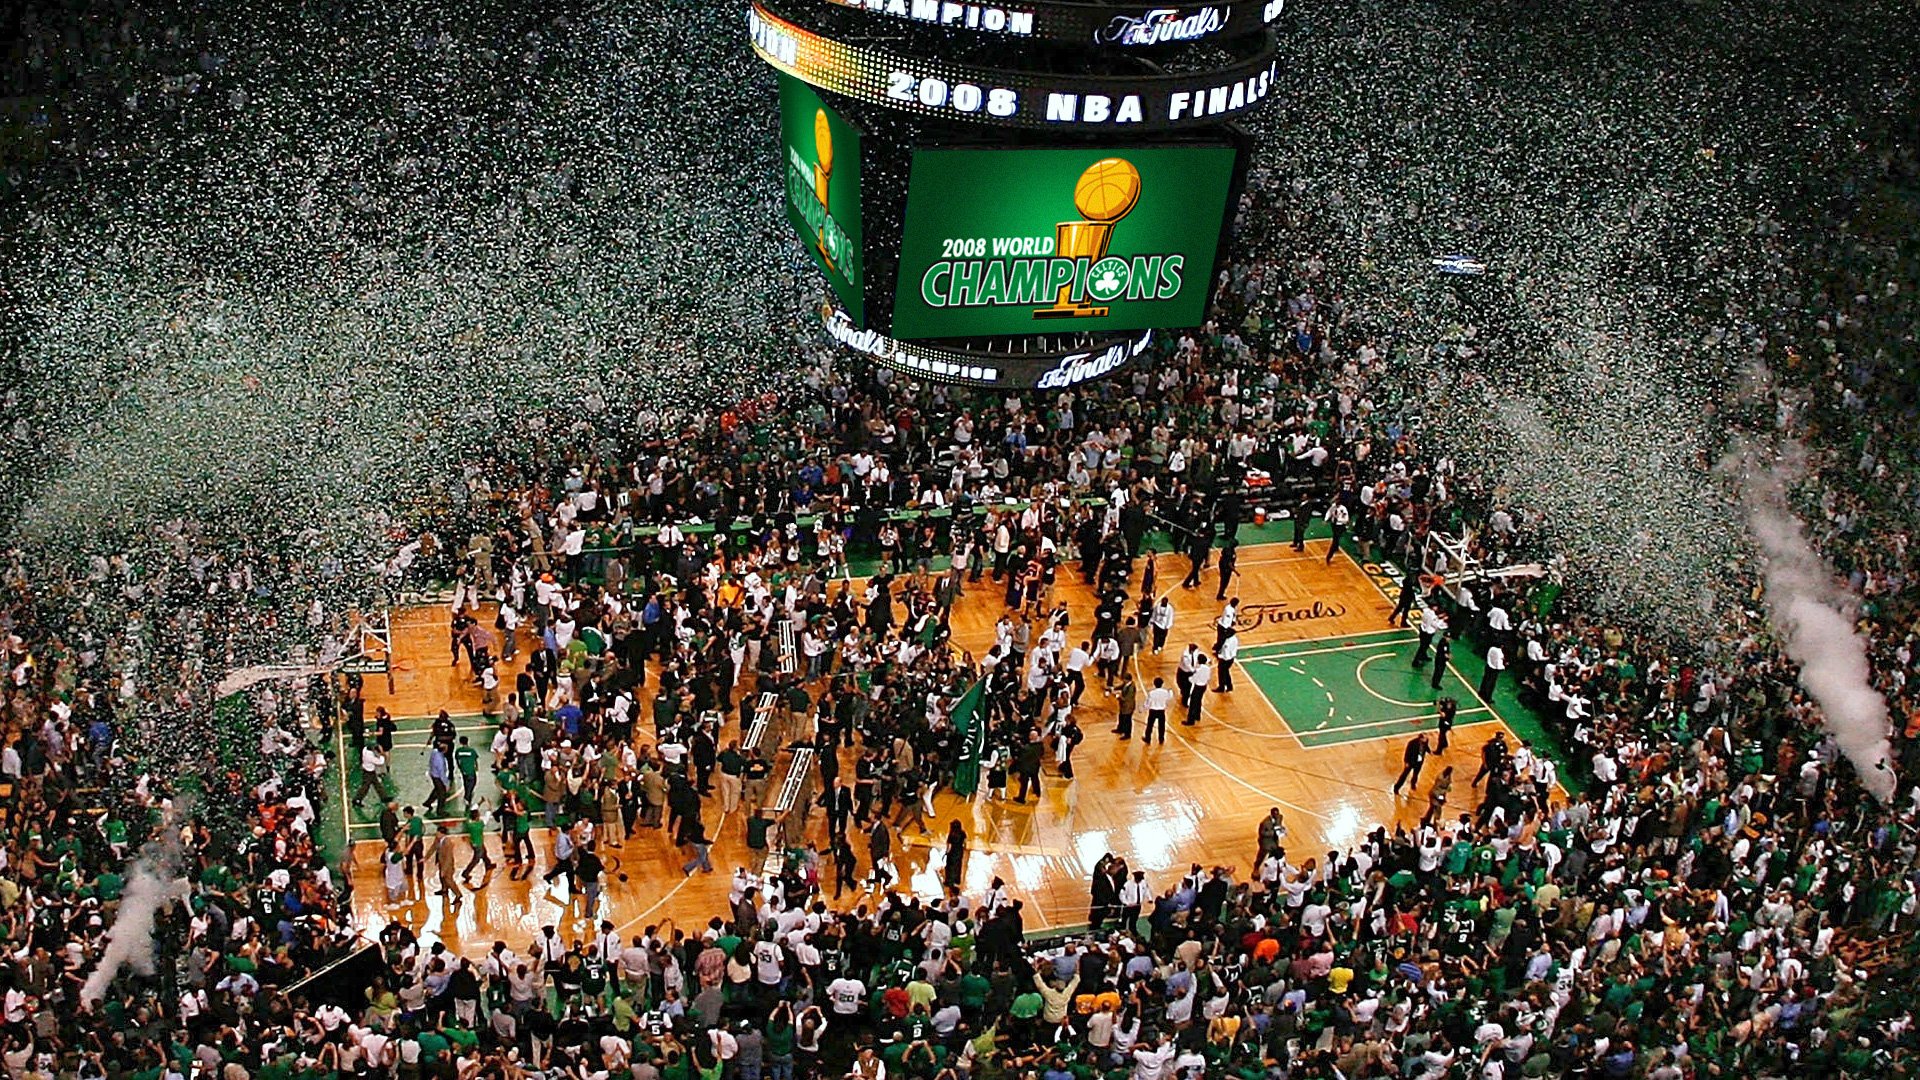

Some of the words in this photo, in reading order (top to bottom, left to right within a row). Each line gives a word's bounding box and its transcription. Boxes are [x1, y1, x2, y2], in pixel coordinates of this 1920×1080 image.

[849, 0, 1033, 34] AMPION
[1144, 6, 1220, 45] Finals
[887, 70, 1017, 116] 2008
[1046, 93, 1142, 122] NBA
[1169, 70, 1269, 120] FINALS
[942, 238, 986, 257] 2008
[992, 237, 1054, 256] WORLD
[921, 254, 1184, 307] CHAMPIONS
[1091, 261, 1127, 278] CELTICS
[894, 351, 997, 381] CHAMPION
[1061, 345, 1123, 387] Finals
[1241, 600, 1345, 632] Finals
